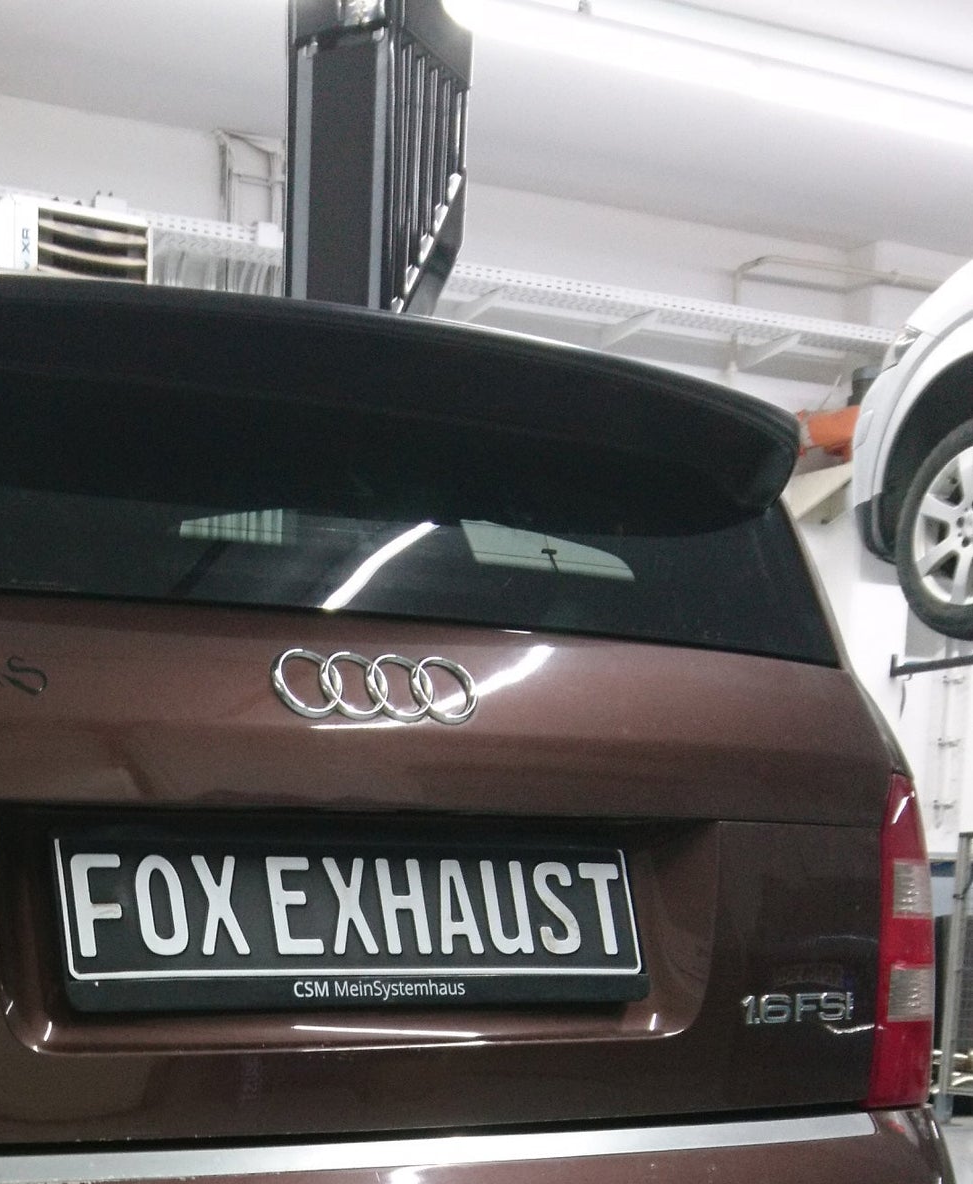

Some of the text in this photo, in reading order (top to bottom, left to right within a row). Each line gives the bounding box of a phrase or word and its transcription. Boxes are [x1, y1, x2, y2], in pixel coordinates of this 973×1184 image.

[70, 853, 618, 957] FOX EXHAUST
[293, 979, 466, 1001] CSM MeinSystemhaus
